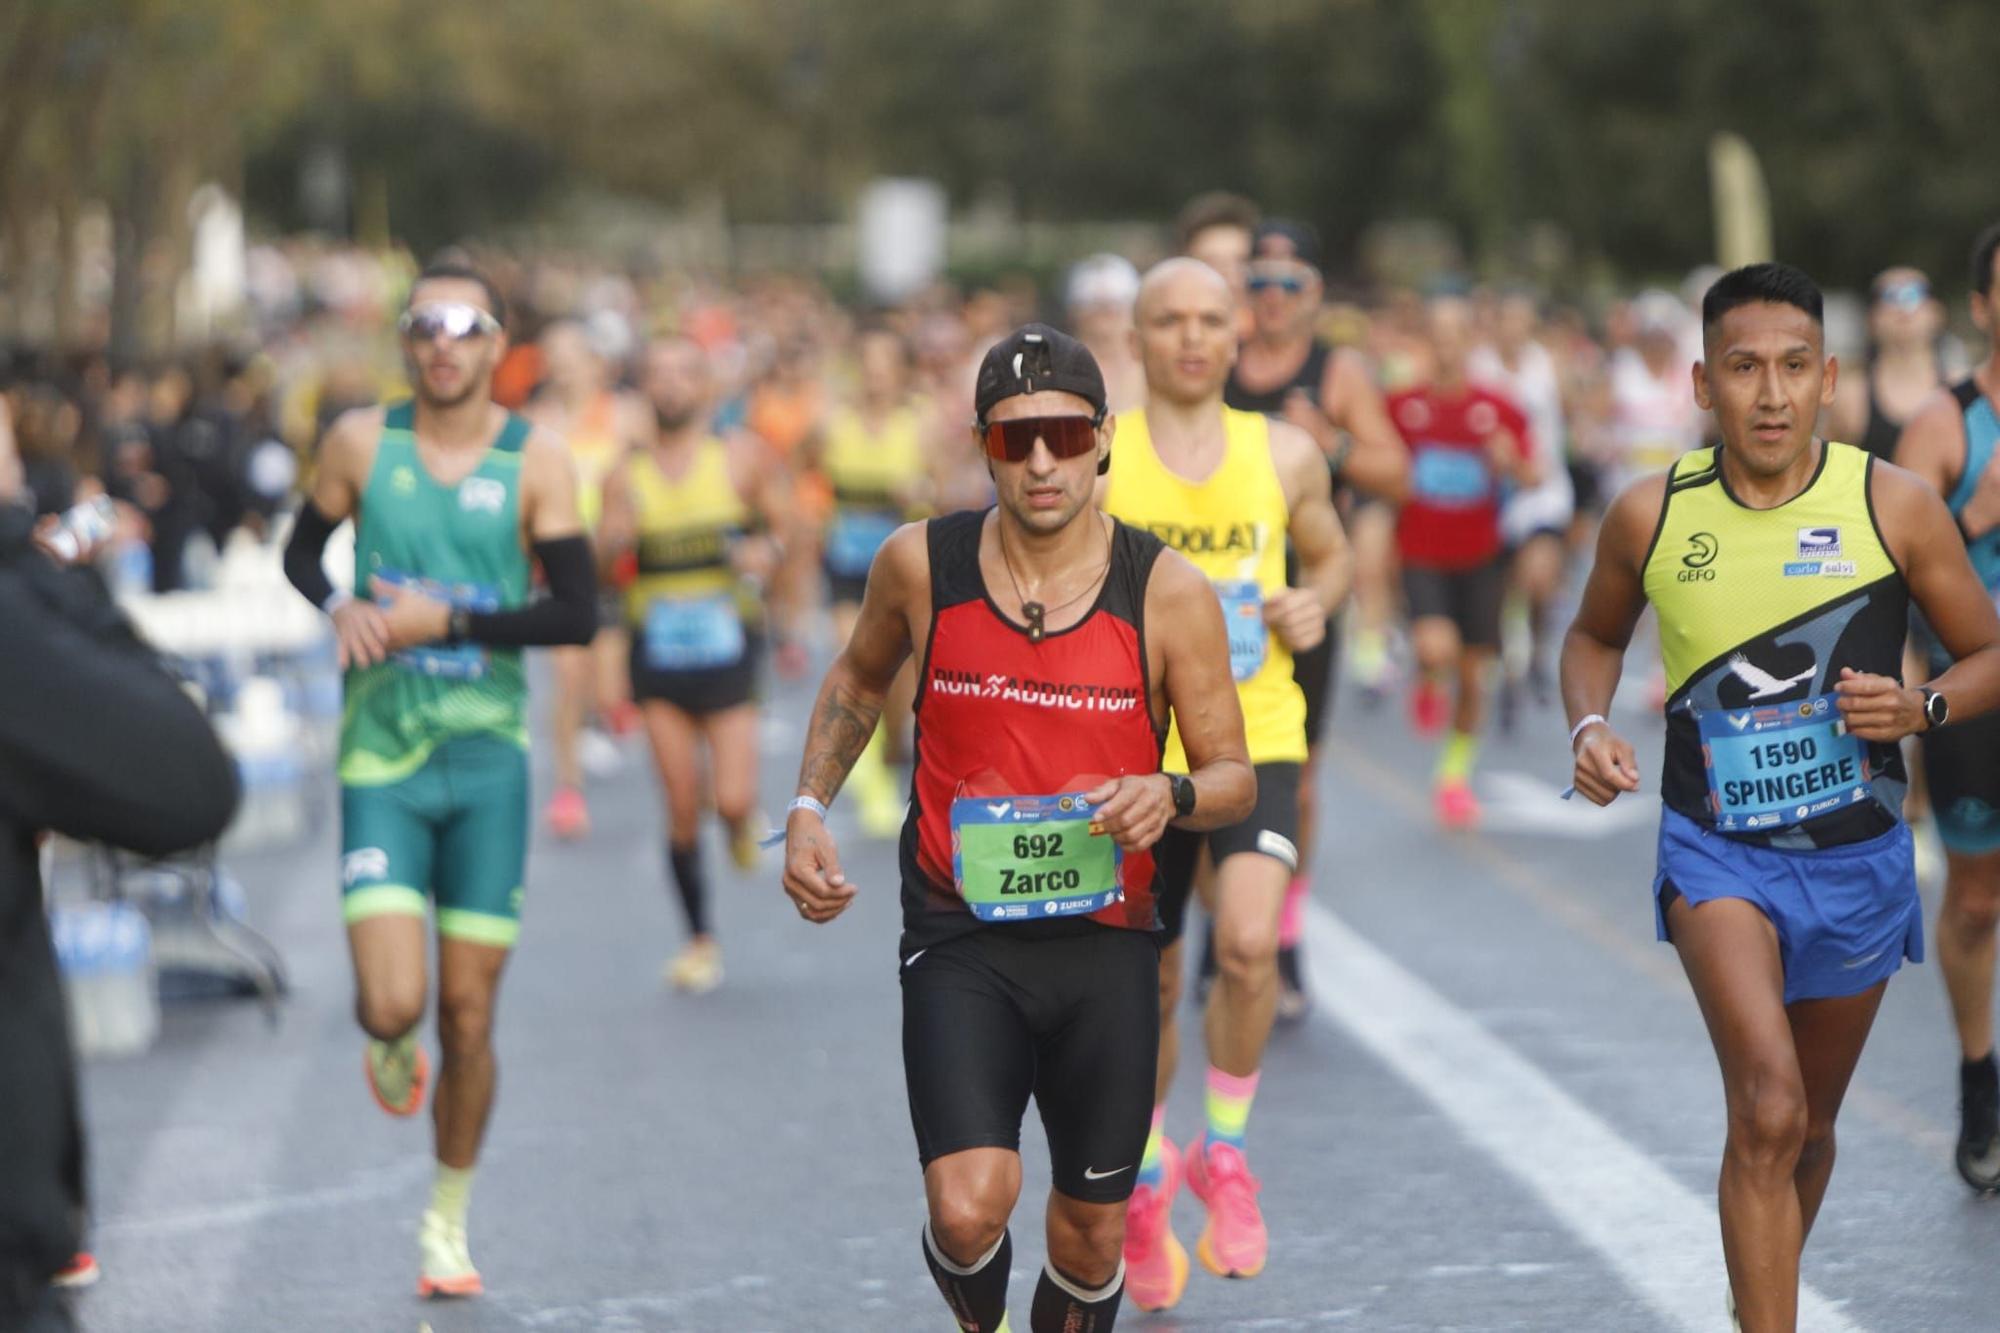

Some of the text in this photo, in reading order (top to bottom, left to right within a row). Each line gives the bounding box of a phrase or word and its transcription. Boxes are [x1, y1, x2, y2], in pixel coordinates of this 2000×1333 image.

[1677, 570, 1715, 582] GEFO
[933, 668, 1137, 711] RUN ADDICTION
[1750, 737, 1817, 769] 1590
[1724, 756, 1855, 806] SPINGERE
[1811, 797, 1841, 812] ZURICH
[1013, 833, 1064, 859] 692
[1000, 868, 1080, 894] Zarco
[1060, 899, 1093, 911] ZURICH
